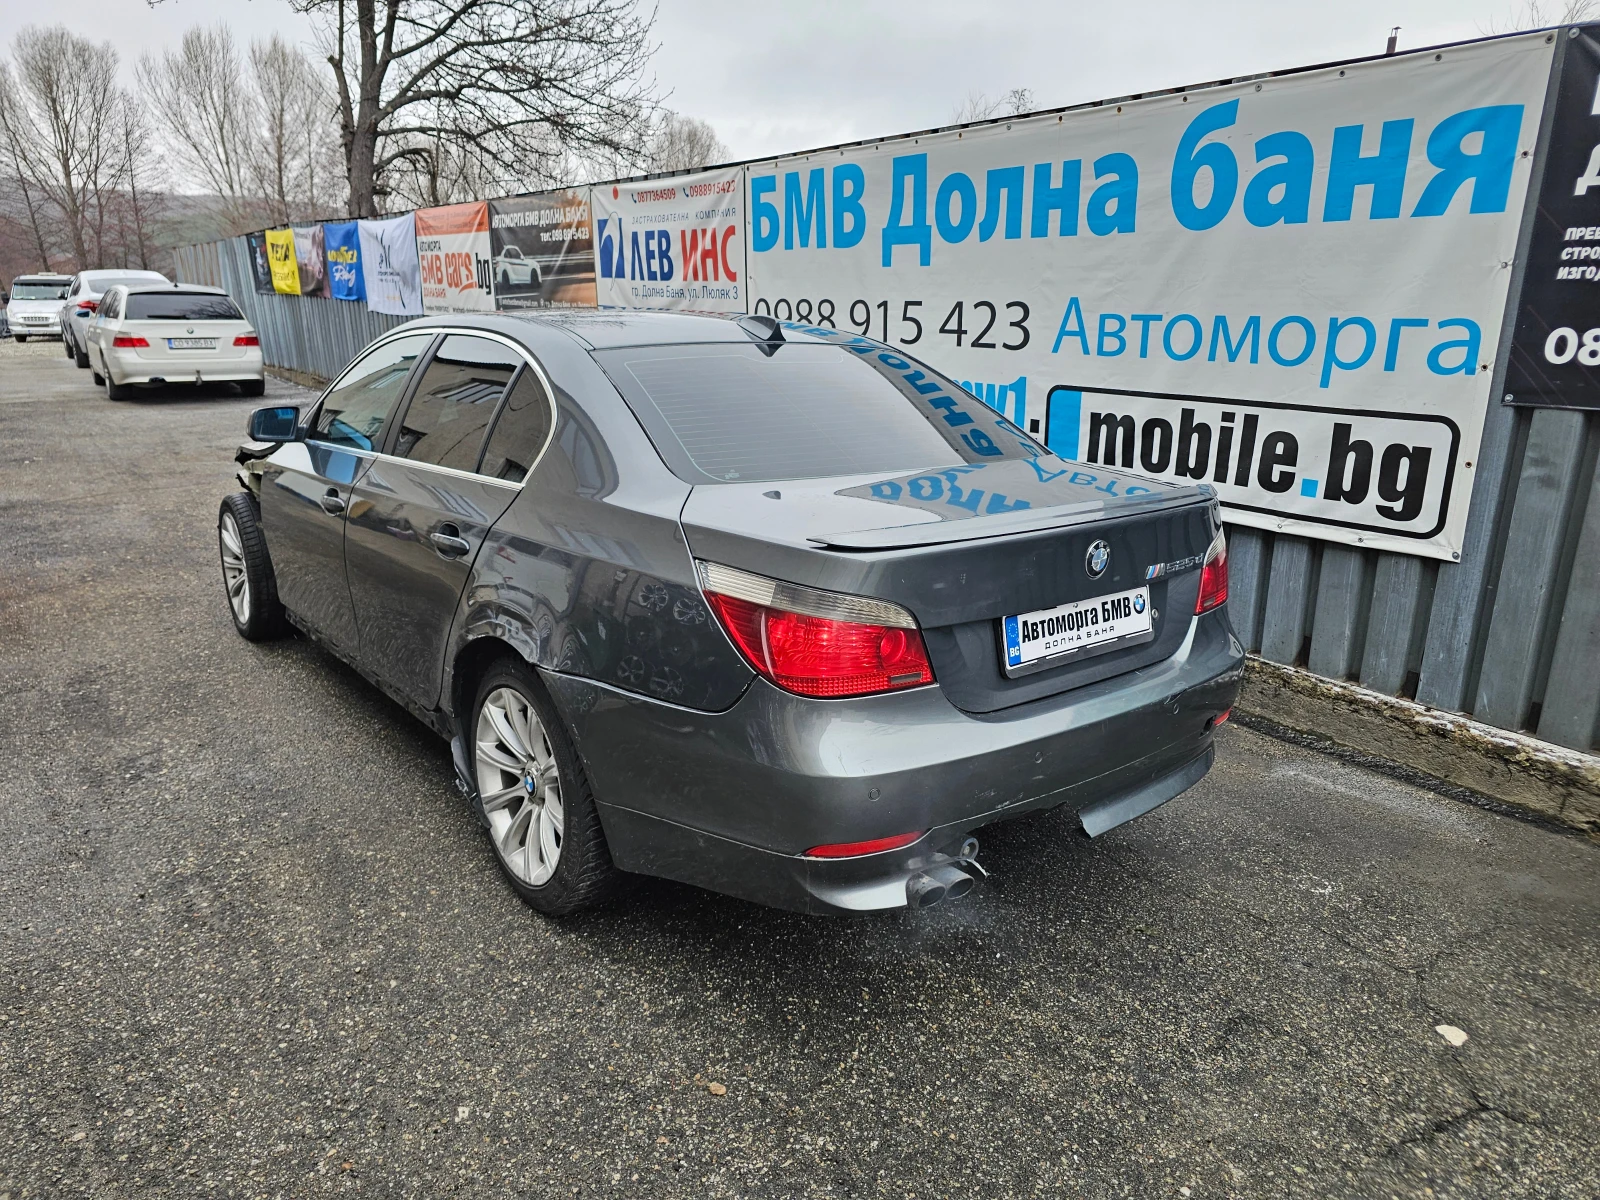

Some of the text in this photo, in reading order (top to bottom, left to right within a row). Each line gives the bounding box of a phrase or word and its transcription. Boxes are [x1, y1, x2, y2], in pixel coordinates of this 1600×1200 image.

[637, 179, 737, 204] 0877364509 0988915423
[751, 162, 867, 253] БМВ
[881, 153, 1139, 267] Долна
[1171, 98, 1525, 231] баня
[525, 210, 539, 226] БМВ
[539, 207, 565, 227] ДОЛНА
[631, 212, 690, 225] ЗАСТРАХОВАТЕЛНА
[631, 225, 738, 282] ЛЕВ ИНС
[1560, 246, 1600, 261] СТРО
[421, 255, 444, 285] БМВ
[631, 285, 739, 302] гр. Долна Баня, ул. Люляк 3
[850, 299, 923, 345] 915
[939, 301, 1031, 351] 423
[1051, 296, 1482, 389] Автоморга
[1544, 327, 1600, 366] 08
[1086, 408, 1433, 522] mobile.bg
[1021, 597, 1132, 644] Автоморга БМВ
[1009, 646, 1021, 658] BG
[1045, 625, 1116, 650] ДОЛНА БАНЯ
